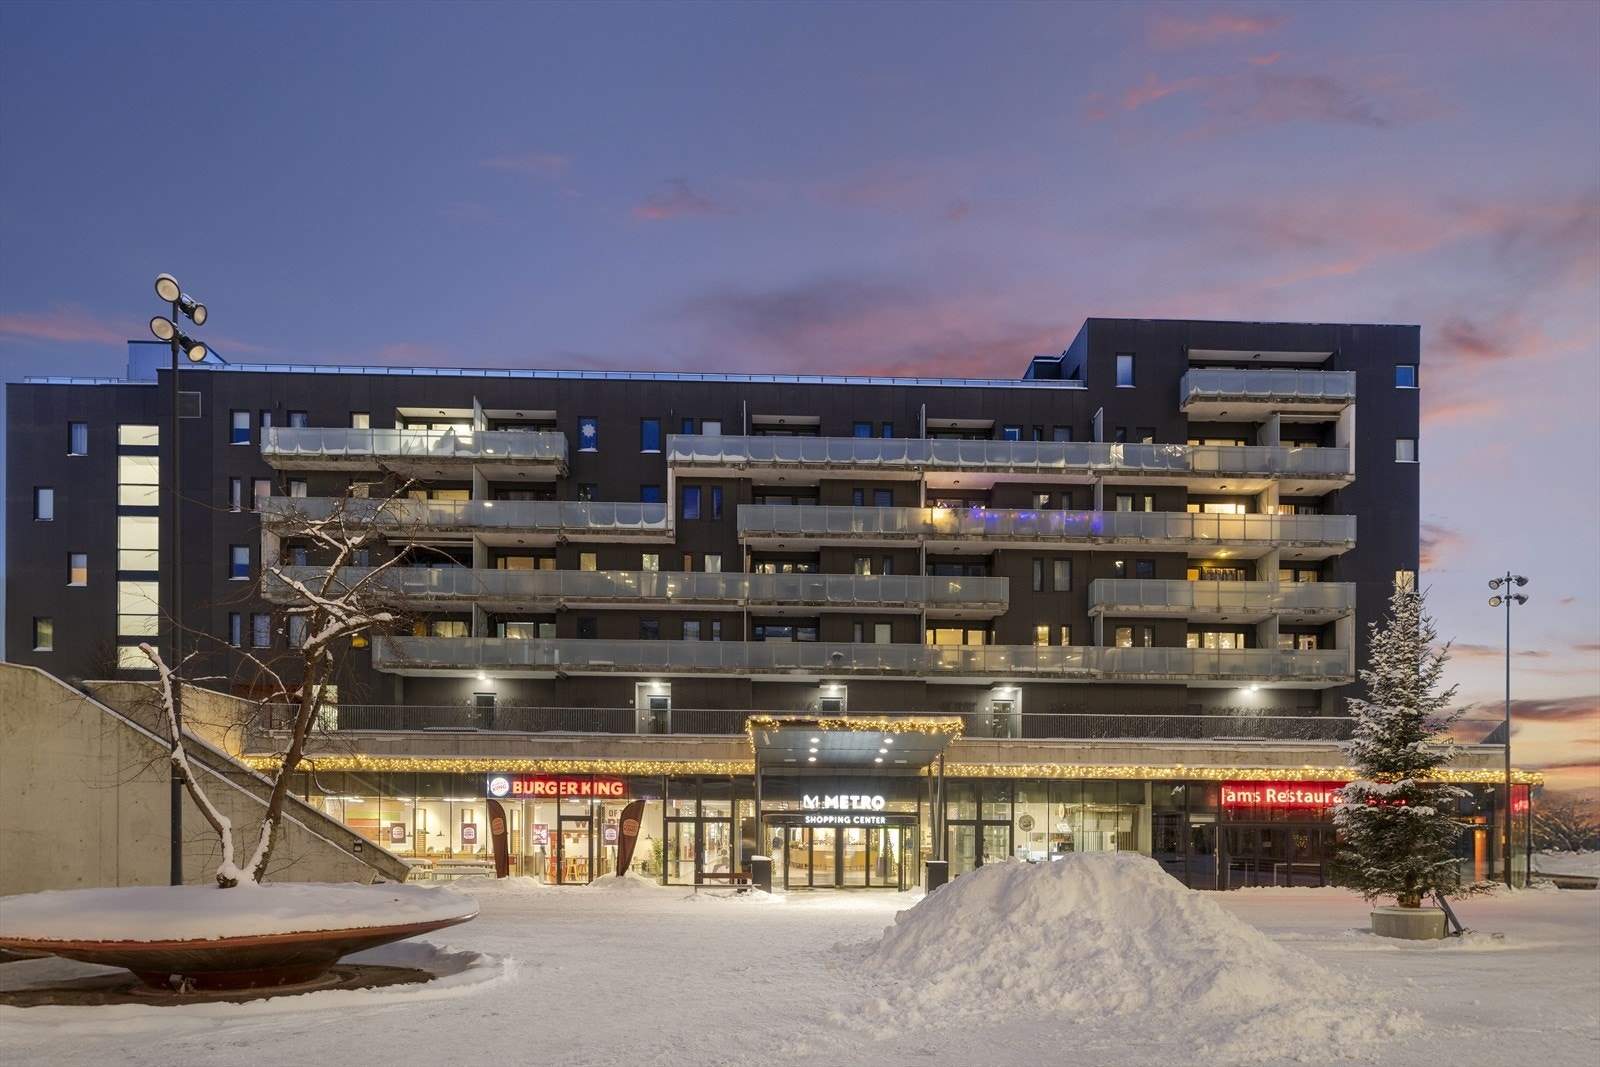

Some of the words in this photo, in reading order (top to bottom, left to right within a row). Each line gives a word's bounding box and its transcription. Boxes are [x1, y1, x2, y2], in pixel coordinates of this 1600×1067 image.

[512, 781, 579, 795] BURGER
[581, 781, 623, 795] KING
[824, 794, 885, 811] METRO
[1266, 788, 1343, 803] Restaura
[805, 816, 851, 824] SHOPPING
[853, 816, 886, 824] CENTER
